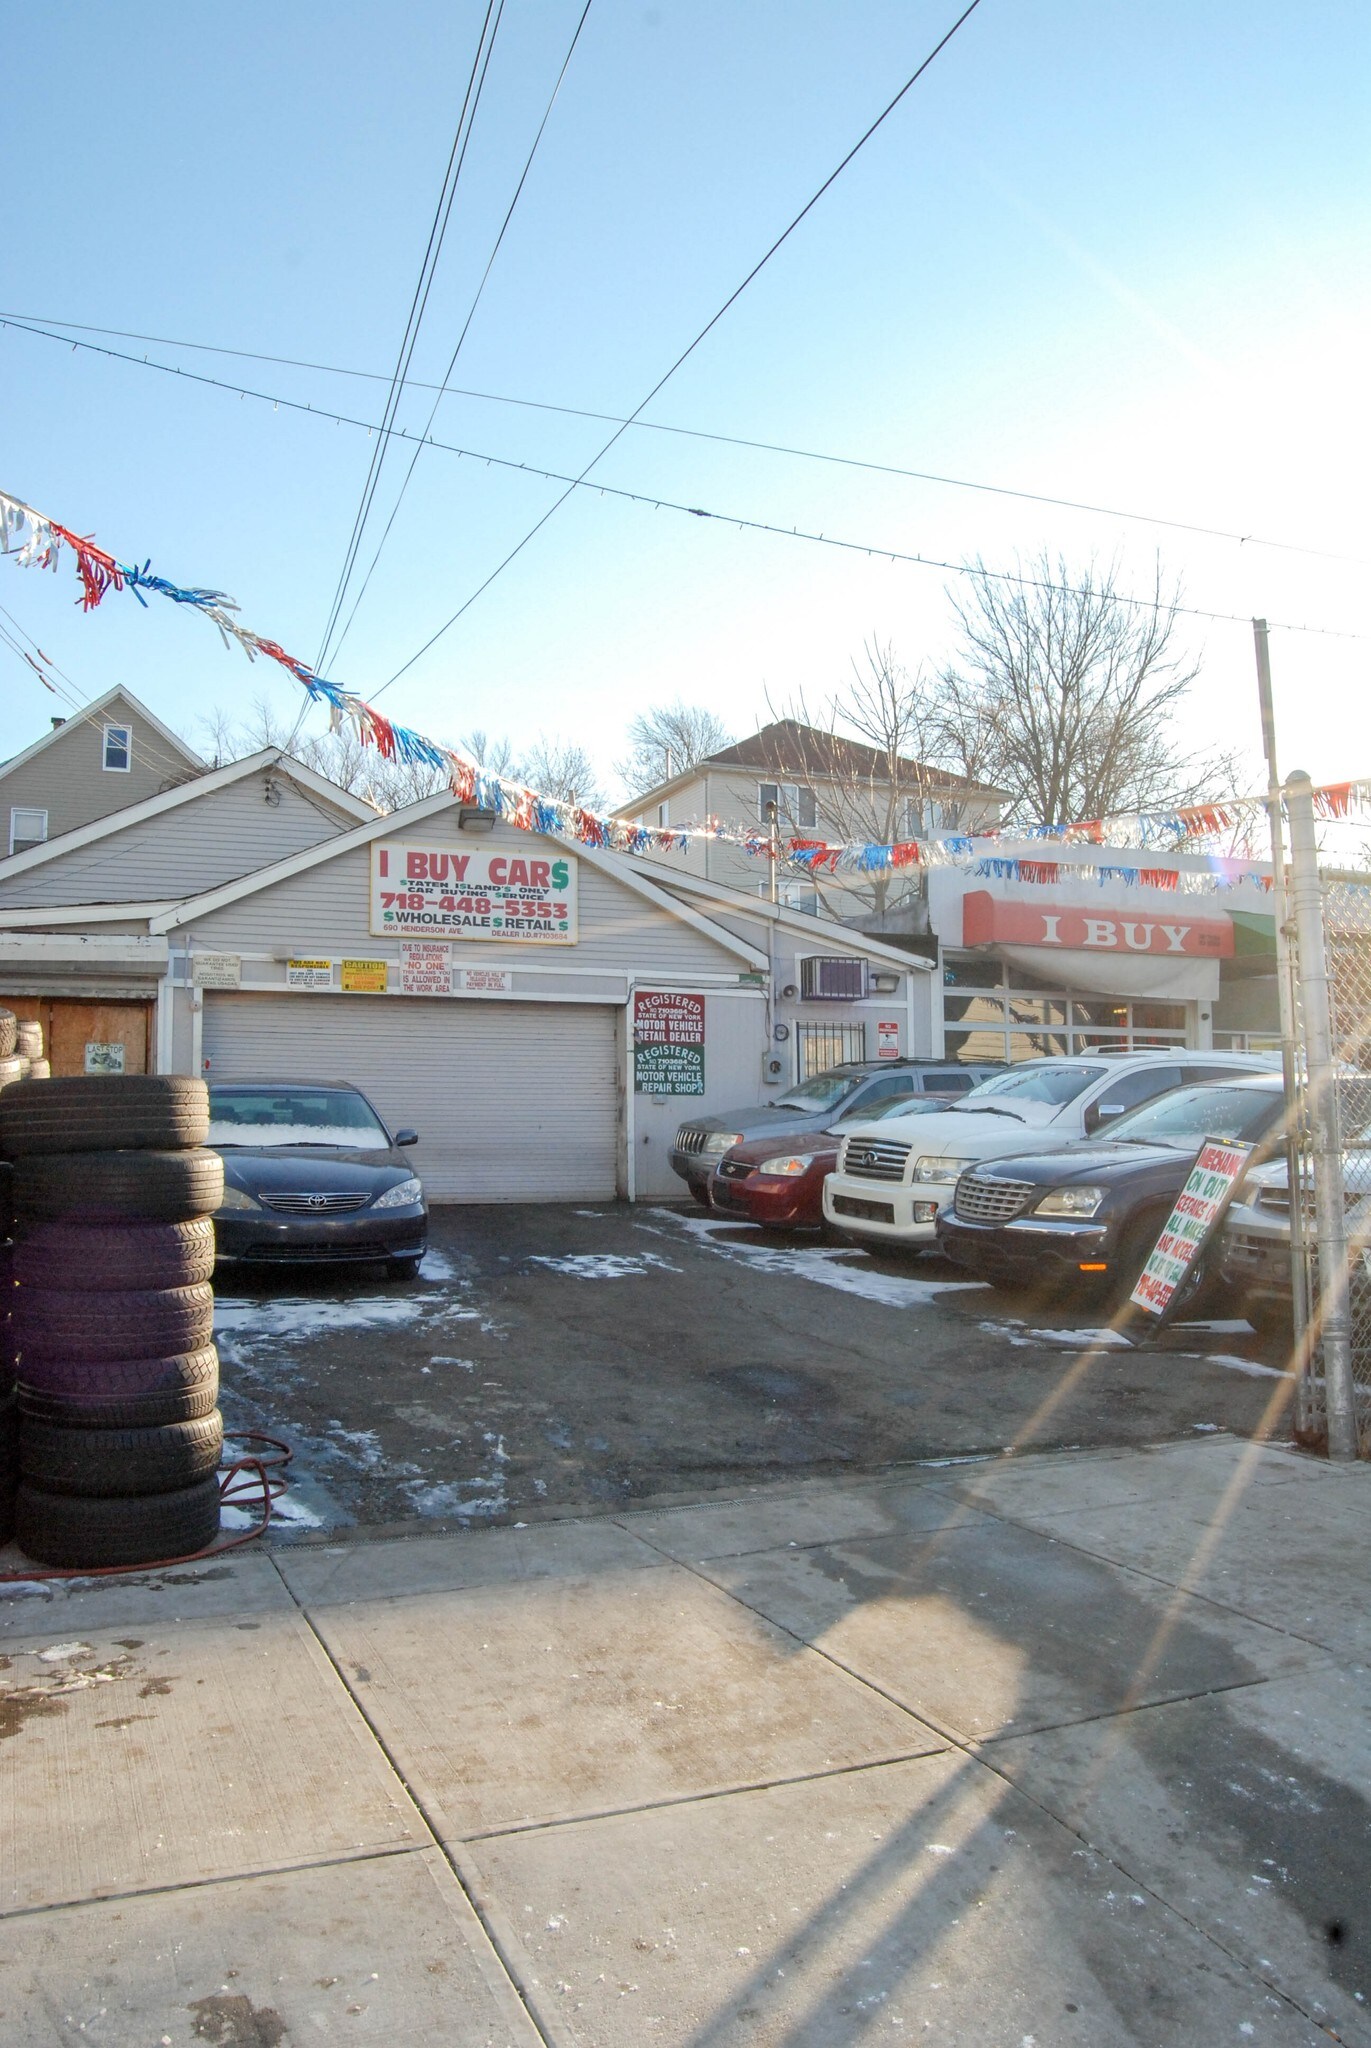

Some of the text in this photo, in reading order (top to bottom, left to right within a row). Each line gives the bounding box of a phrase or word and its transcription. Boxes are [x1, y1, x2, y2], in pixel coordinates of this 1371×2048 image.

[380, 850, 388, 877] I
[407, 851, 470, 882] BUY
[407, 886, 434, 895] CAR
[440, 888, 488, 898] BUYING
[519, 887, 549, 895] ONLY
[380, 892, 568, 920] 718-448-5353
[383, 924, 398, 932] 690
[401, 925, 446, 934] HENDERSON
[491, 929, 520, 938] DEALER
[1041, 916, 1062, 942] I
[1082, 918, 1192, 951] BUY
[402, 944, 449, 953] DUE TO INSURANCE
[345, 961, 384, 970] CAUTION
[402, 975, 450, 984] IS ALLOWED IN
[403, 984, 450, 993] THE WORK AREA
[638, 994, 701, 1013] REGISTERED
[637, 1019, 703, 1031] MOTOR VEHICLE
[638, 1031, 701, 1042] RETAIL DEALER
[87, 1045, 122, 1054] LAST STOP
[637, 1045, 701, 1064] REGISTERED
[636, 1071, 702, 1082] MOTOR VEHICLE
[642, 1082, 697, 1093] REPAIR SHOP
[1187, 1171, 1231, 1201] ON DUTY
[1175, 1194, 1209, 1219] REPAIRS
[1165, 1214, 1183, 1234] ALL
[1156, 1234, 1173, 1253] AND
